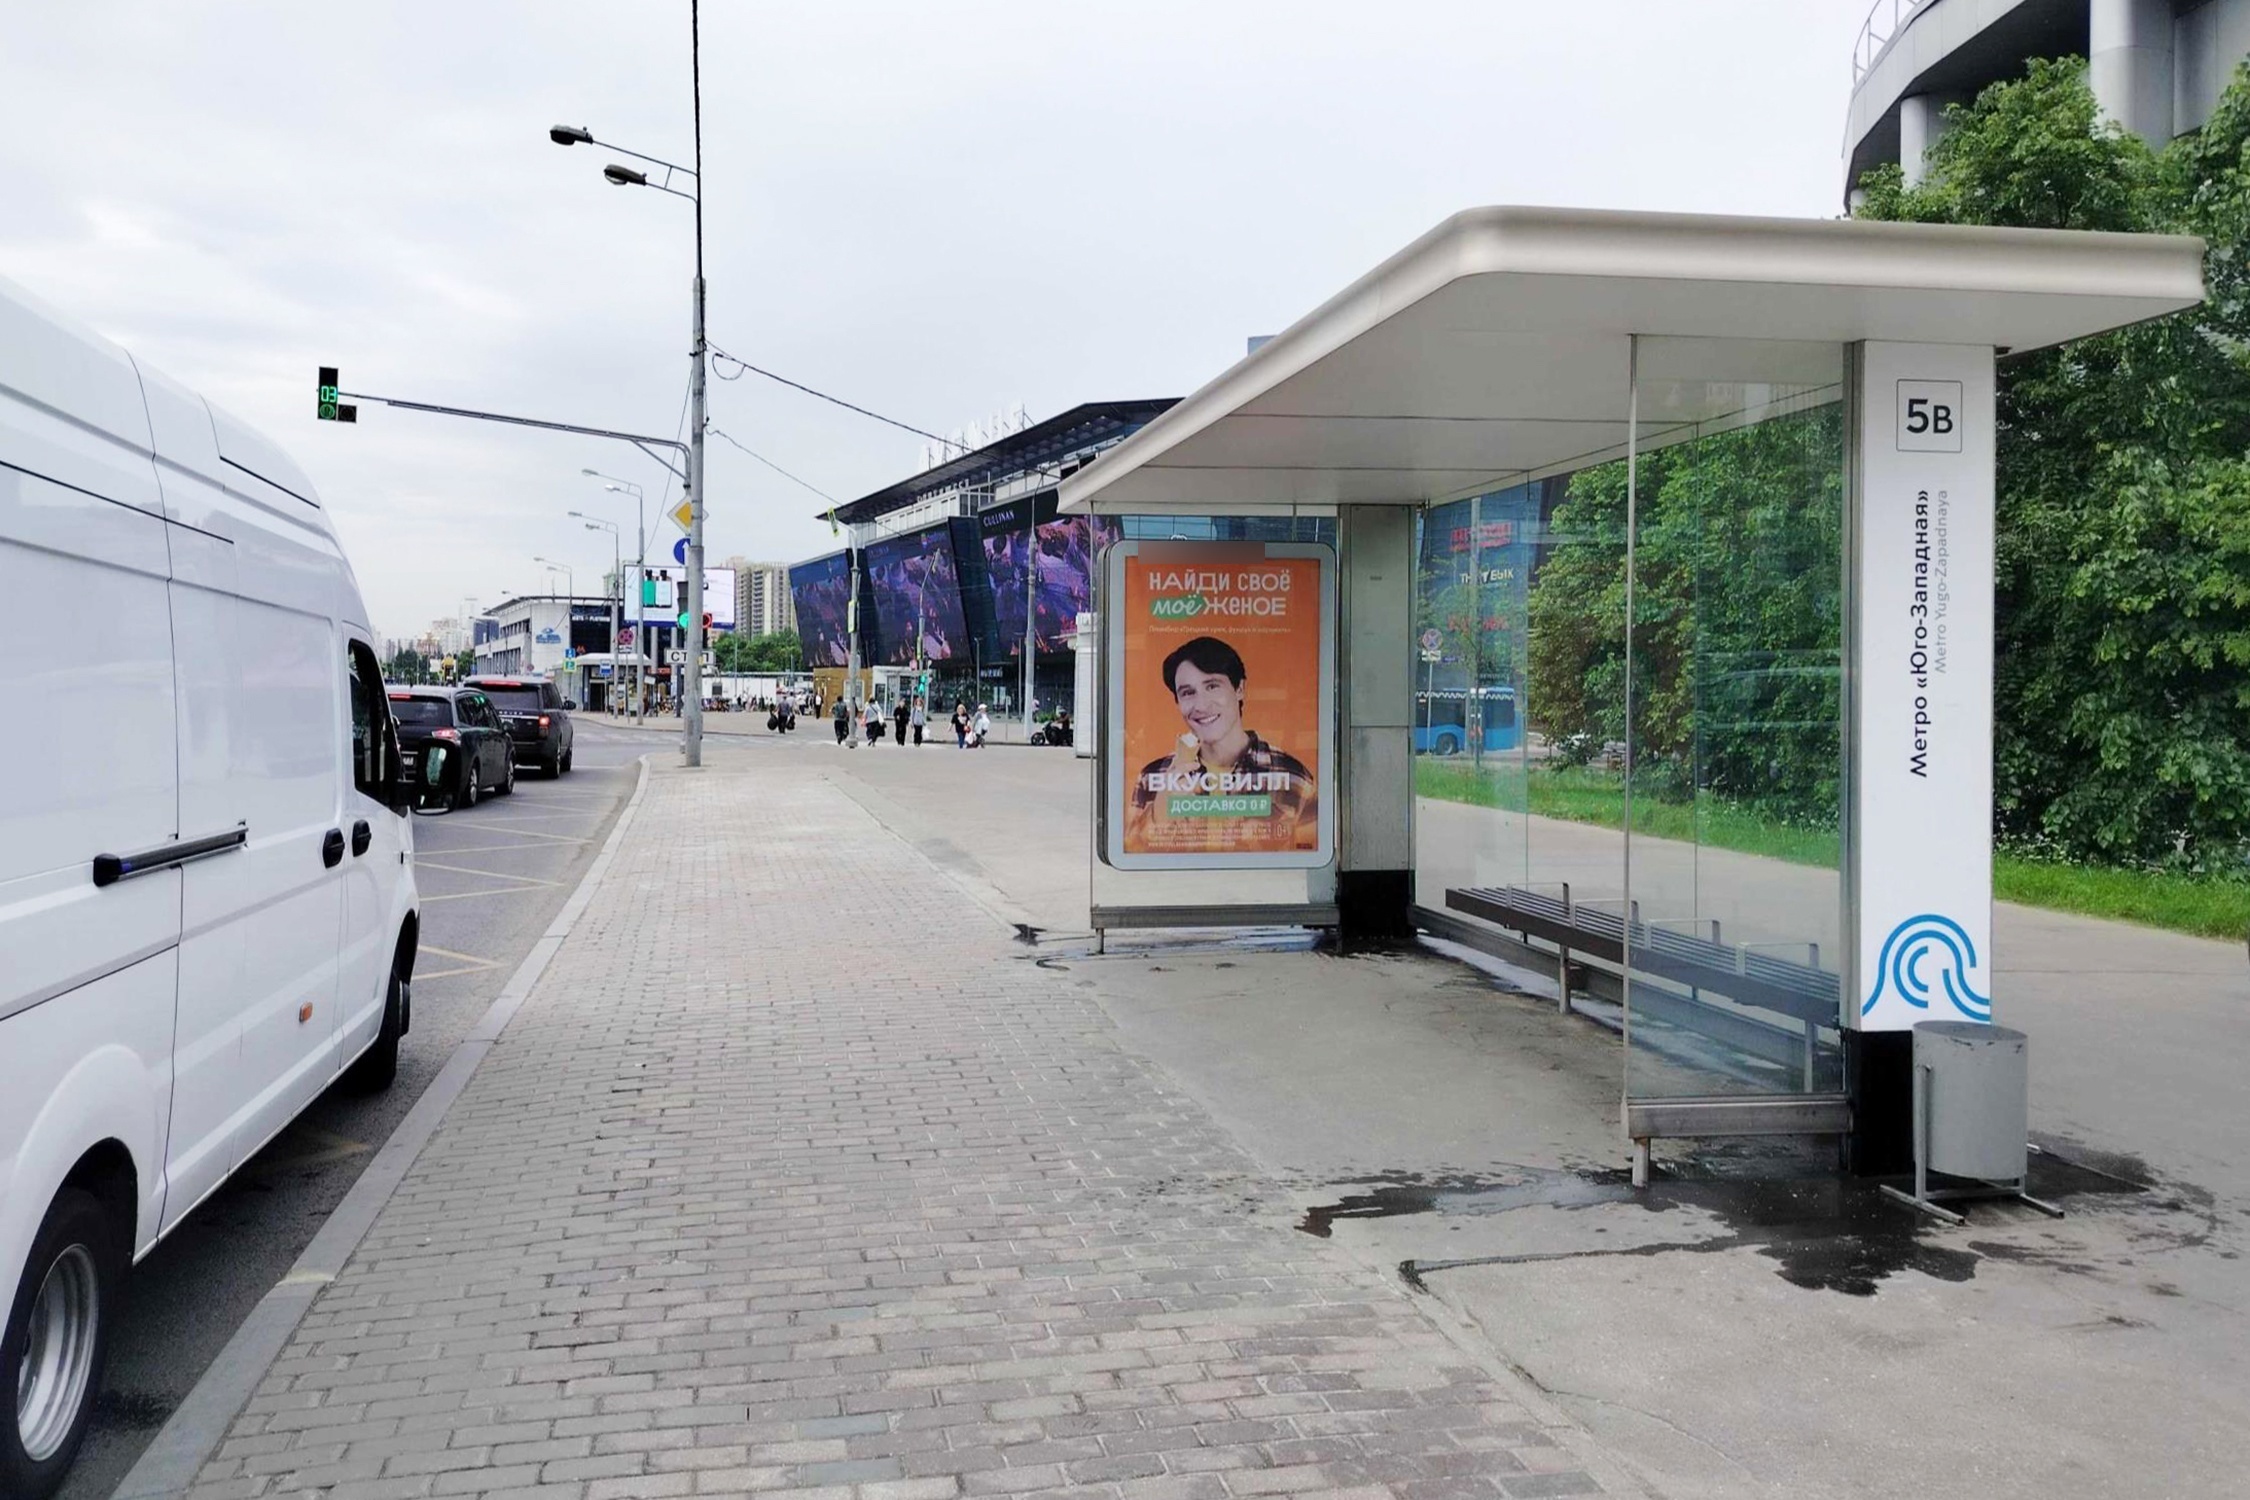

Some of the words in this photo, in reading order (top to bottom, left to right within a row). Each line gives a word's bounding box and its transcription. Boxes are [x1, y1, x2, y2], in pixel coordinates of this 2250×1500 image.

[321, 385, 337, 403] 03
[1935, 490, 1950, 620] Yugo-Zapadnaya
[1149, 569, 1230, 594] НАЙДИ
[1910, 490, 1931, 689] «Юго-Западная»
[671, 651, 709, 662] СТП
[1935, 624, 1947, 674] Metro
[1910, 696, 1931, 778] Метро
[1148, 772, 1291, 792] ВКУСВИЛЛ
